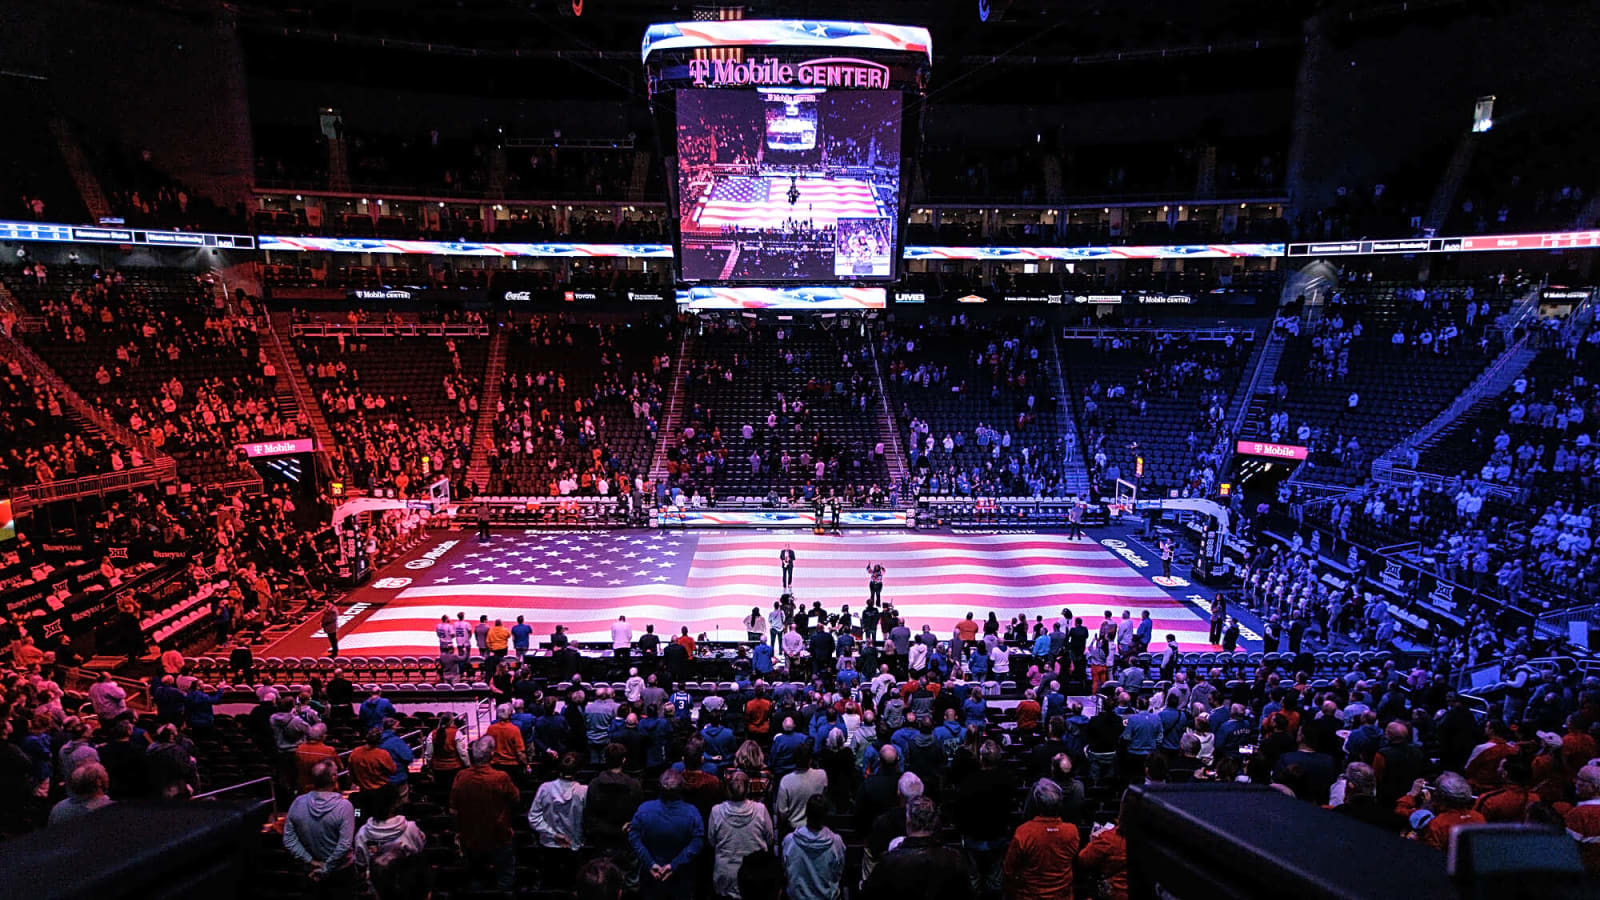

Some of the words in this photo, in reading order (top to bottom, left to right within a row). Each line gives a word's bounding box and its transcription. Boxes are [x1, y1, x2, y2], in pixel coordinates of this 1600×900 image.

[711, 57, 793, 86] Mobile
[798, 64, 883, 88] CENTER
[895, 293, 925, 301] UMB
[264, 442, 295, 454] Mobile
[1263, 445, 1295, 457] Mobile
[678, 700, 686, 710] 3
